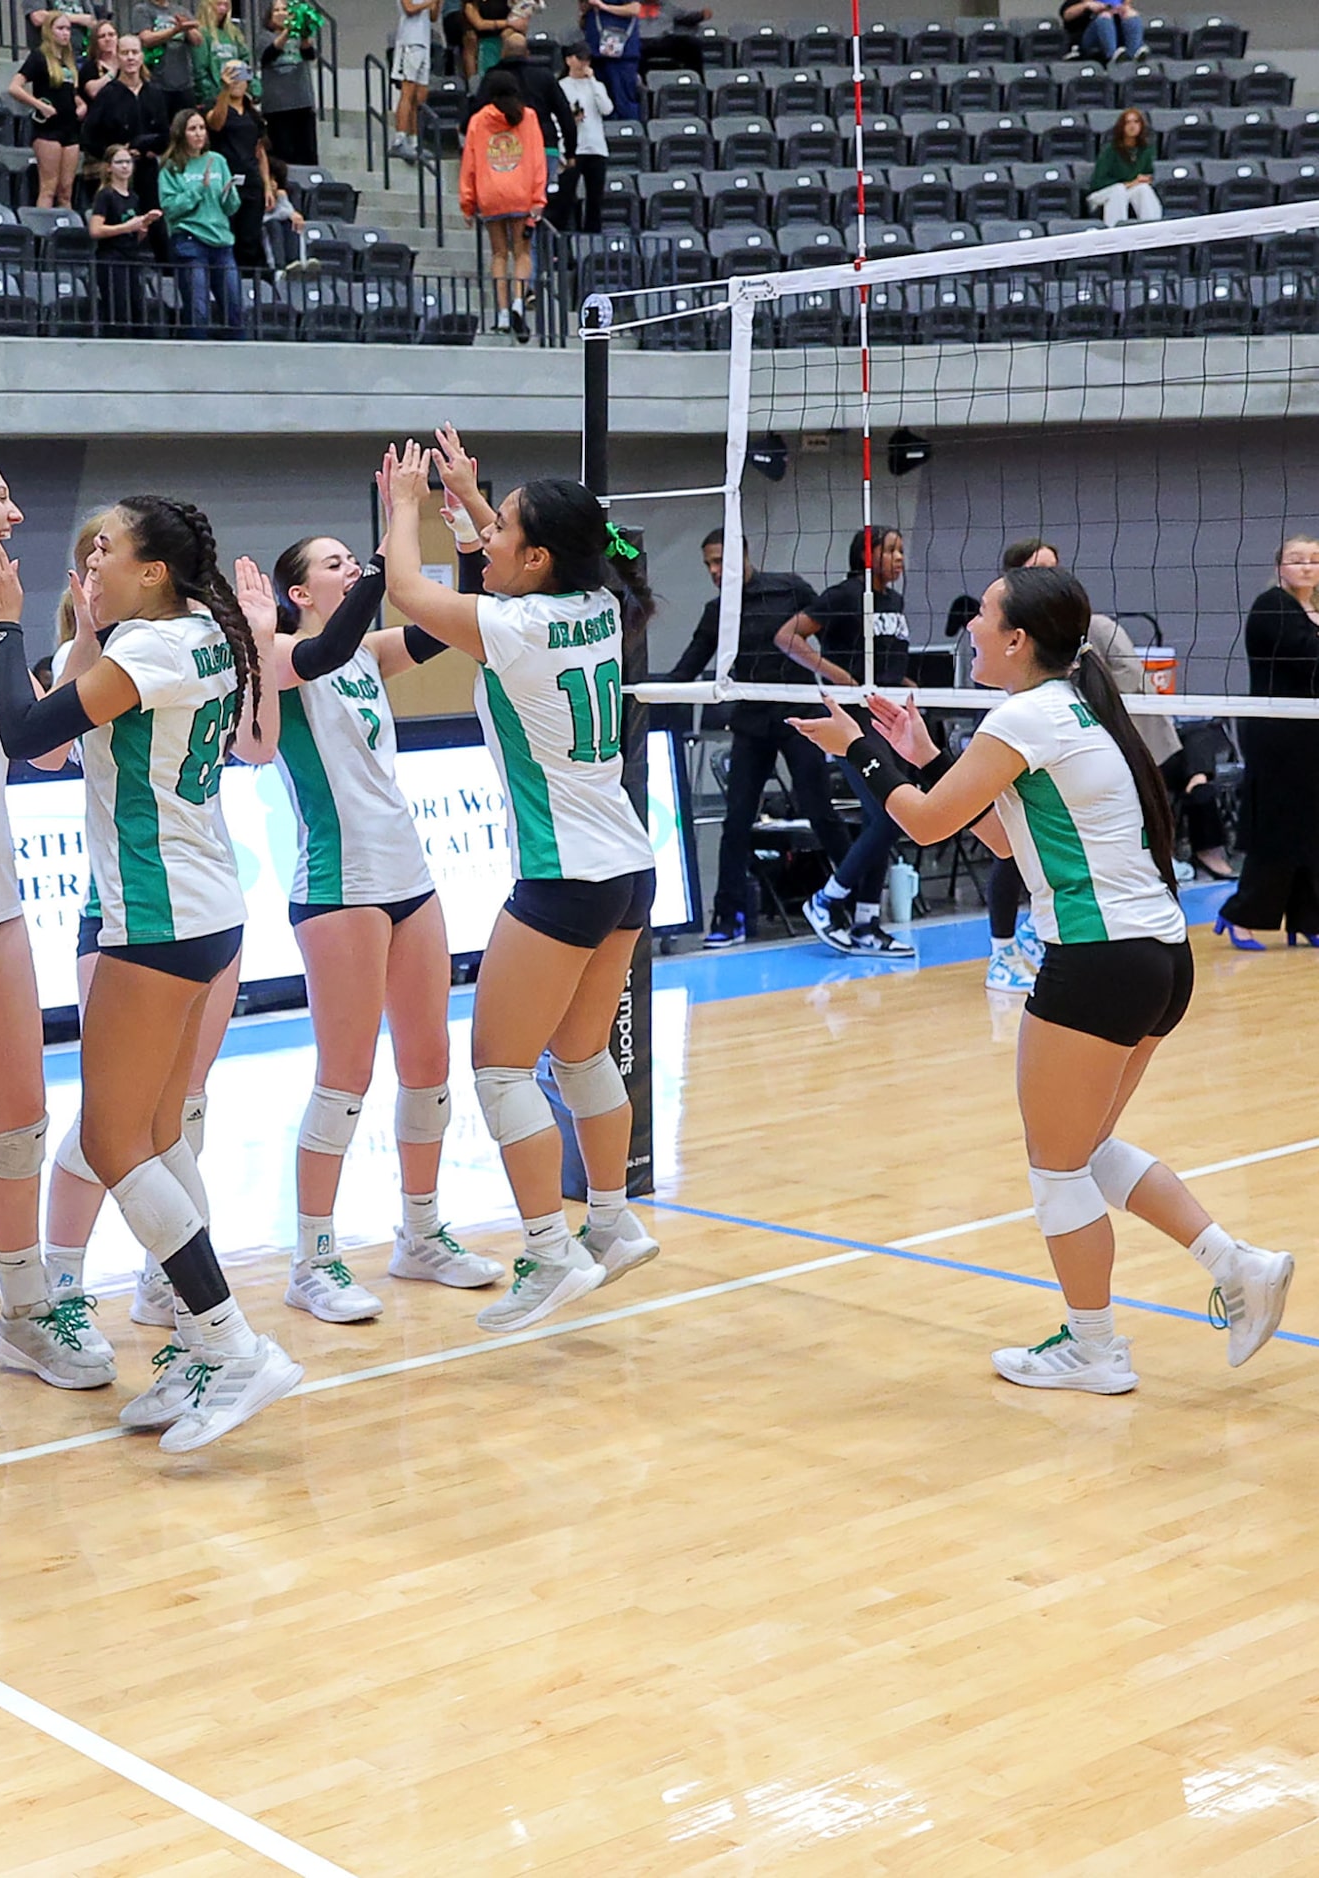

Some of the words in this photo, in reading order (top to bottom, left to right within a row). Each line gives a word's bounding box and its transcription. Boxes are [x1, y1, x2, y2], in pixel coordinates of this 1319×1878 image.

[548, 608, 616, 649] DRAGONS
[358, 708, 381, 751] 7
[556, 657, 622, 763] 10
